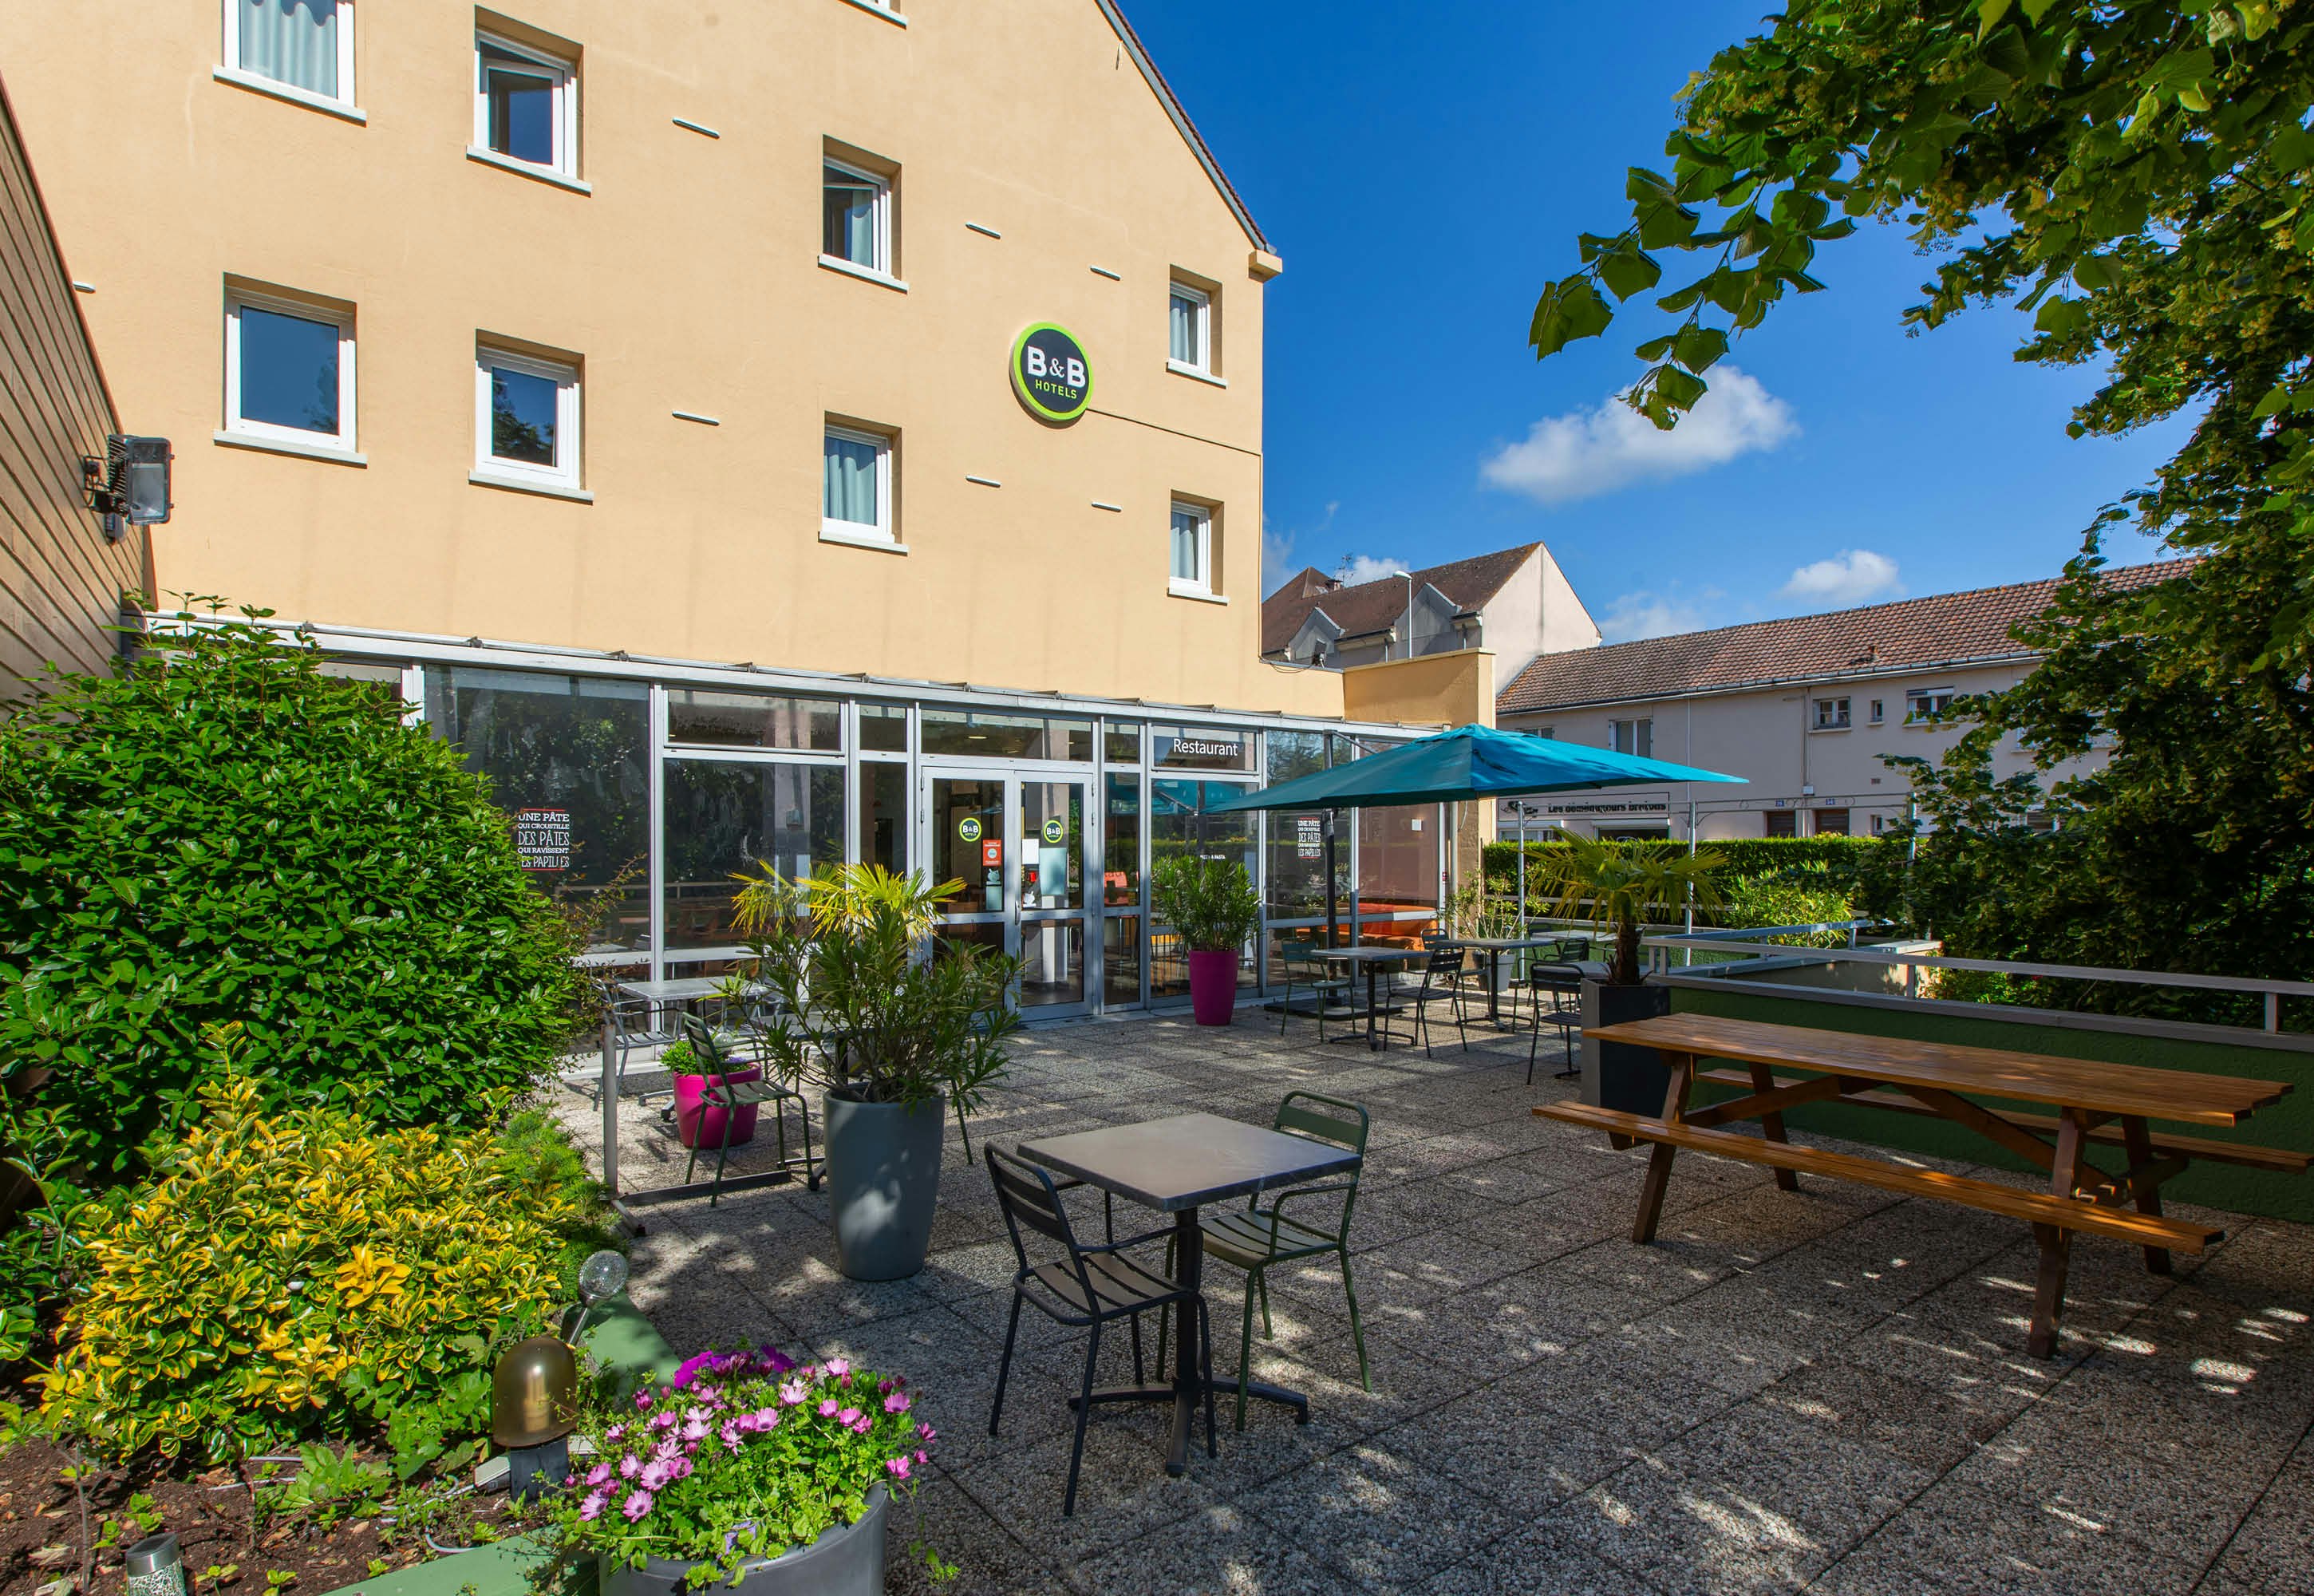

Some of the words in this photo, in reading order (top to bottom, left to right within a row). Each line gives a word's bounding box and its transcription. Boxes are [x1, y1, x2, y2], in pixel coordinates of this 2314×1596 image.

[1027, 346, 1086, 388] B&B
[1035, 379, 1077, 399] HOTELS
[1174, 738, 1238, 757] Restaurant
[519, 812, 541, 821] UNE
[543, 812, 570, 822] PÂTE
[518, 830, 536, 846] DES
[539, 829, 570, 846] PÂTES
[519, 855, 532, 867] ES
